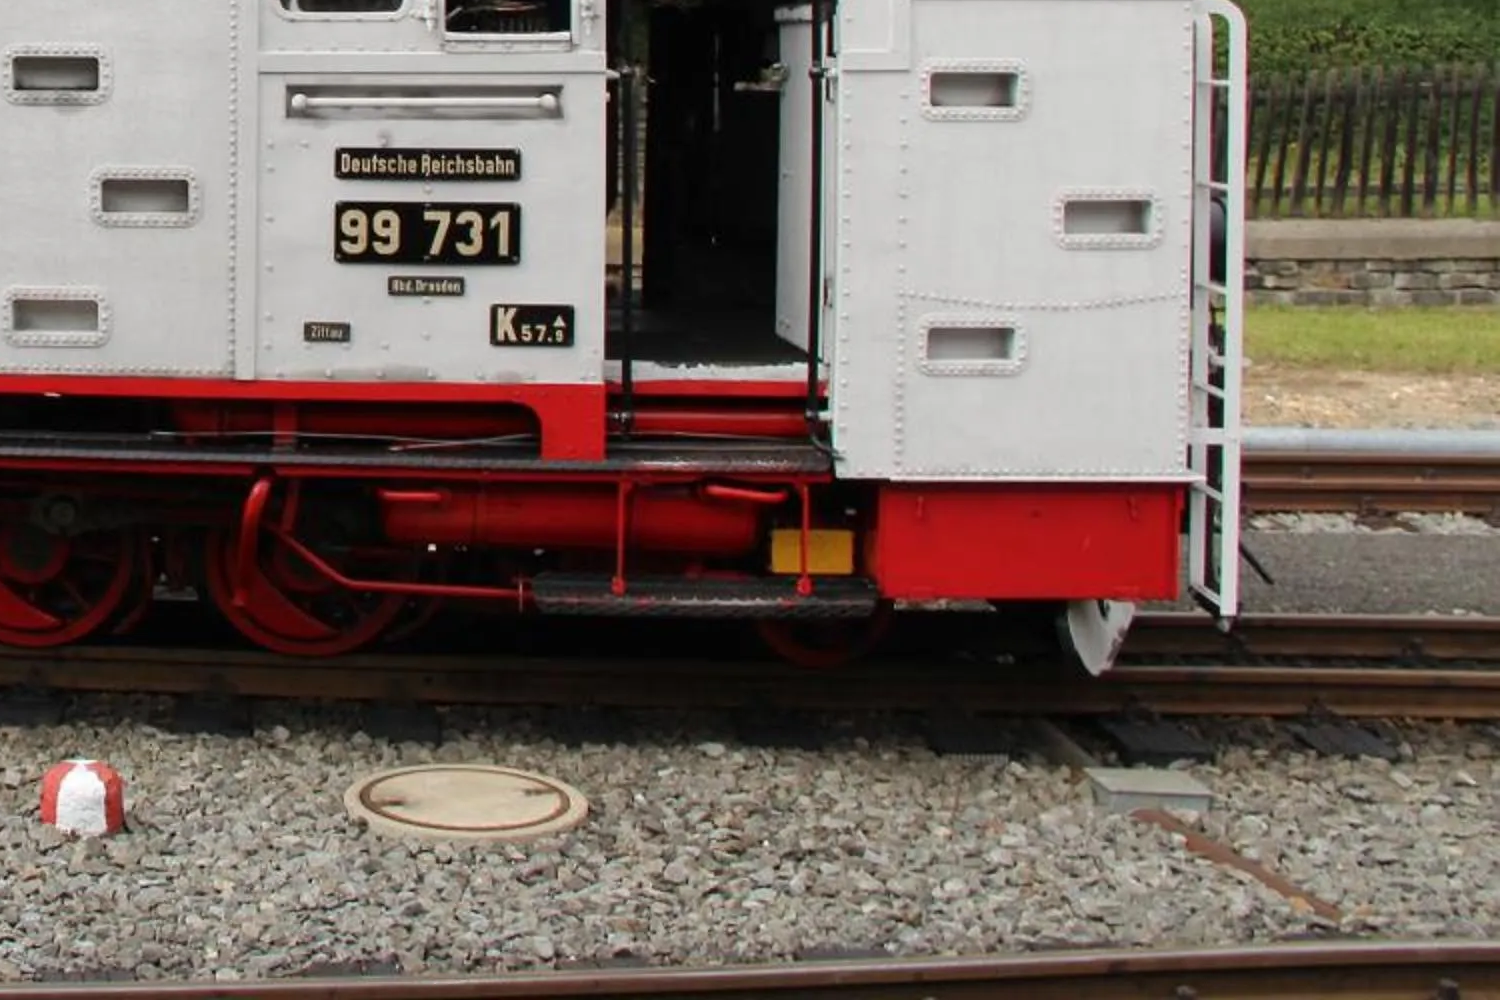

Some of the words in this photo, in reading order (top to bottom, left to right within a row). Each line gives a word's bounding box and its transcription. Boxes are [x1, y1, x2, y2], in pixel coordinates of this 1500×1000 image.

[340, 153, 417, 174] Deutsche
[421, 153, 515, 176] Reichsbahn
[339, 209, 400, 255] 99
[423, 210, 510, 257] 731
[497, 307, 517, 341] K
